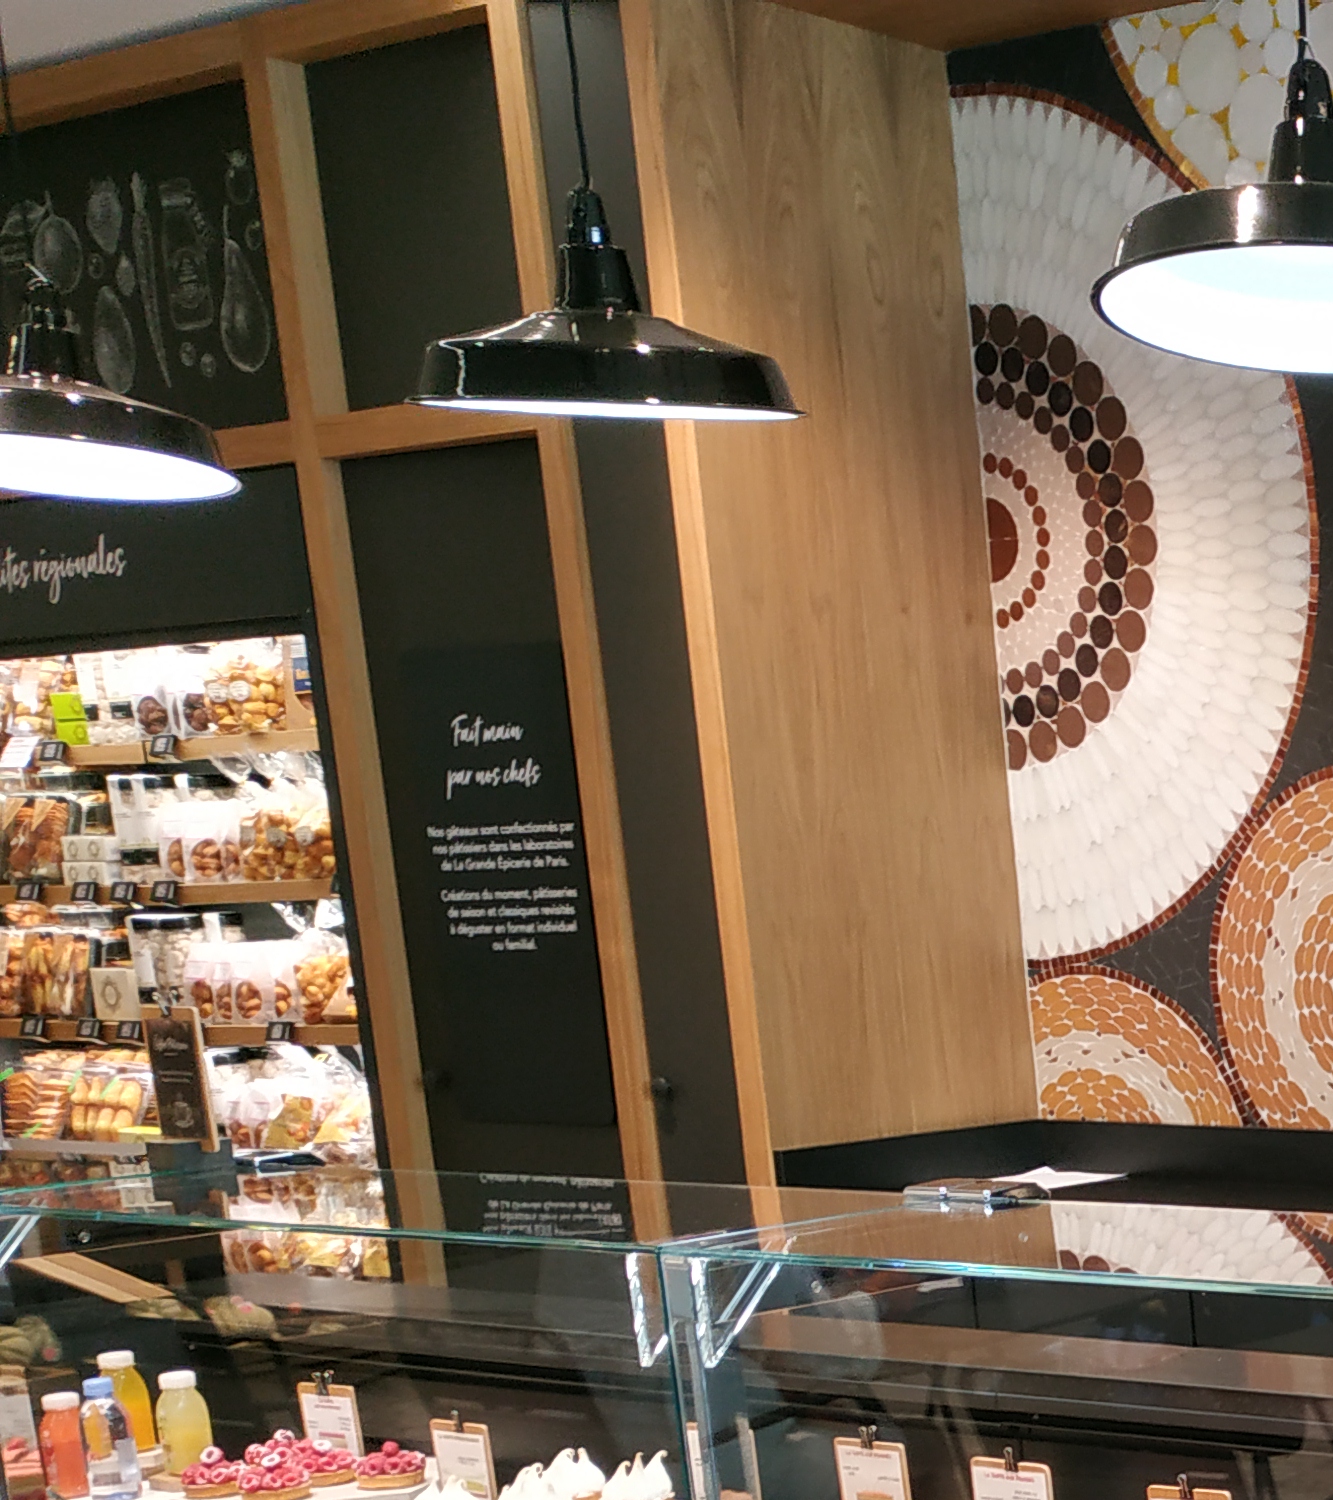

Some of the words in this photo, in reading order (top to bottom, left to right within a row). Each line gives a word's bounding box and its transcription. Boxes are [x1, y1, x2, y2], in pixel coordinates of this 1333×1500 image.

[33, 533, 127, 605] régionales
[450, 713, 485, 747] Fait
[482, 722, 524, 743] main
[446, 768, 474, 801] par
[475, 766, 502, 787] nos
[502, 757, 542, 788] chefs
[465, 857, 496, 871] Grande
[532, 855, 545, 868] de
